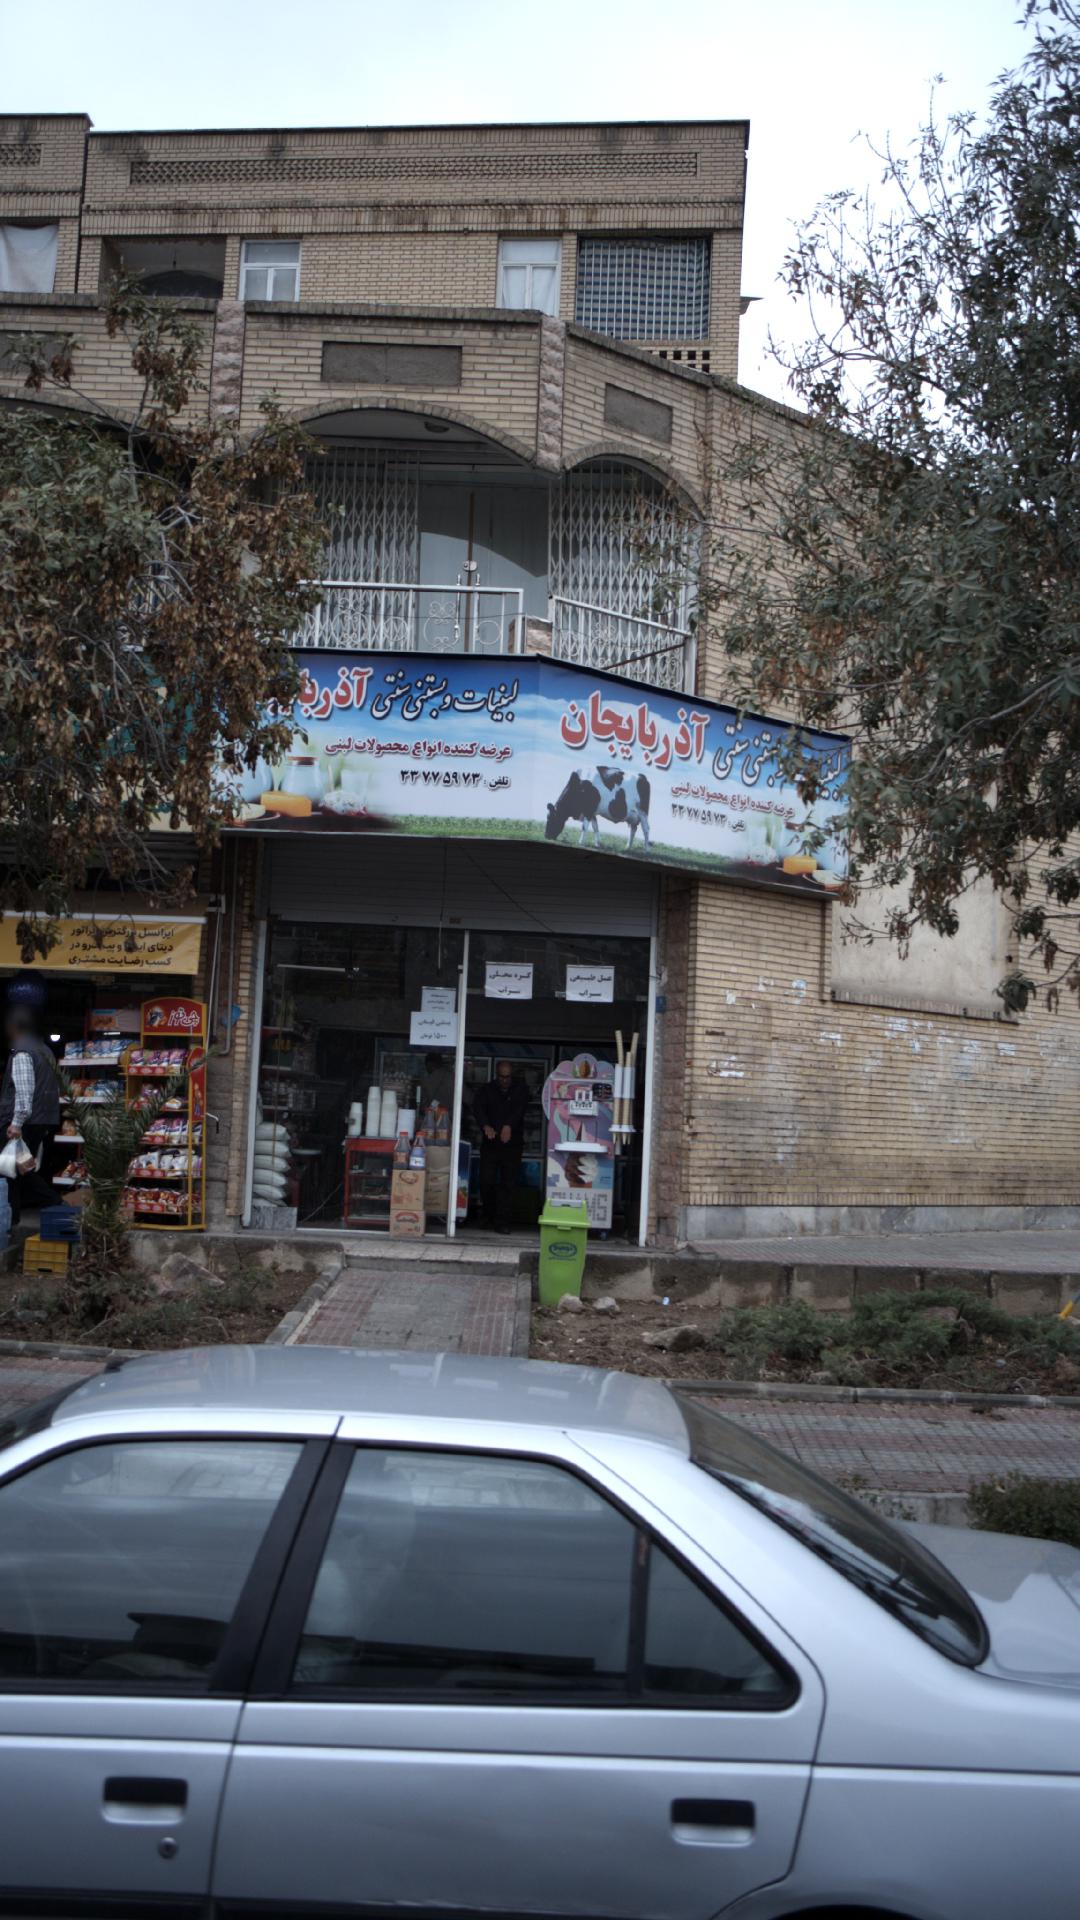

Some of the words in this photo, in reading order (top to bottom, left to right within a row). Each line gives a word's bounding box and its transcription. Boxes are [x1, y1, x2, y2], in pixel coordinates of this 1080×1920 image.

[267, 666, 373, 718] آذربا
[371, 669, 411, 720] سنتی
[402, 674, 448, 721] بستنی
[453, 679, 519, 722] لبنیات
[440, 693, 451, 711] و
[560, 690, 710, 768] آذربایجان
[325, 737, 352, 755] لبنی
[354, 738, 409, 758] محصولات
[412, 740, 442, 759] انواع
[444, 742, 478, 757] کننده
[480, 746, 511, 762] عرضه
[712, 722, 750, 780] سنتی
[671, 782, 690, 797] لبنی
[690, 784, 729, 804] محصولات
[729, 793, 751, 810] انواع
[750, 800, 773, 814] کننده
[773, 802, 795, 818] عرضه
[138, 928, 174, 938] ایرانسل
[70, 942, 80, 951] در
[147, 943, 173, 954] دیتای
[68, 954, 105, 965] مشتری
[107, 955, 144, 967] رضایت
[146, 956, 172, 965] کسب
